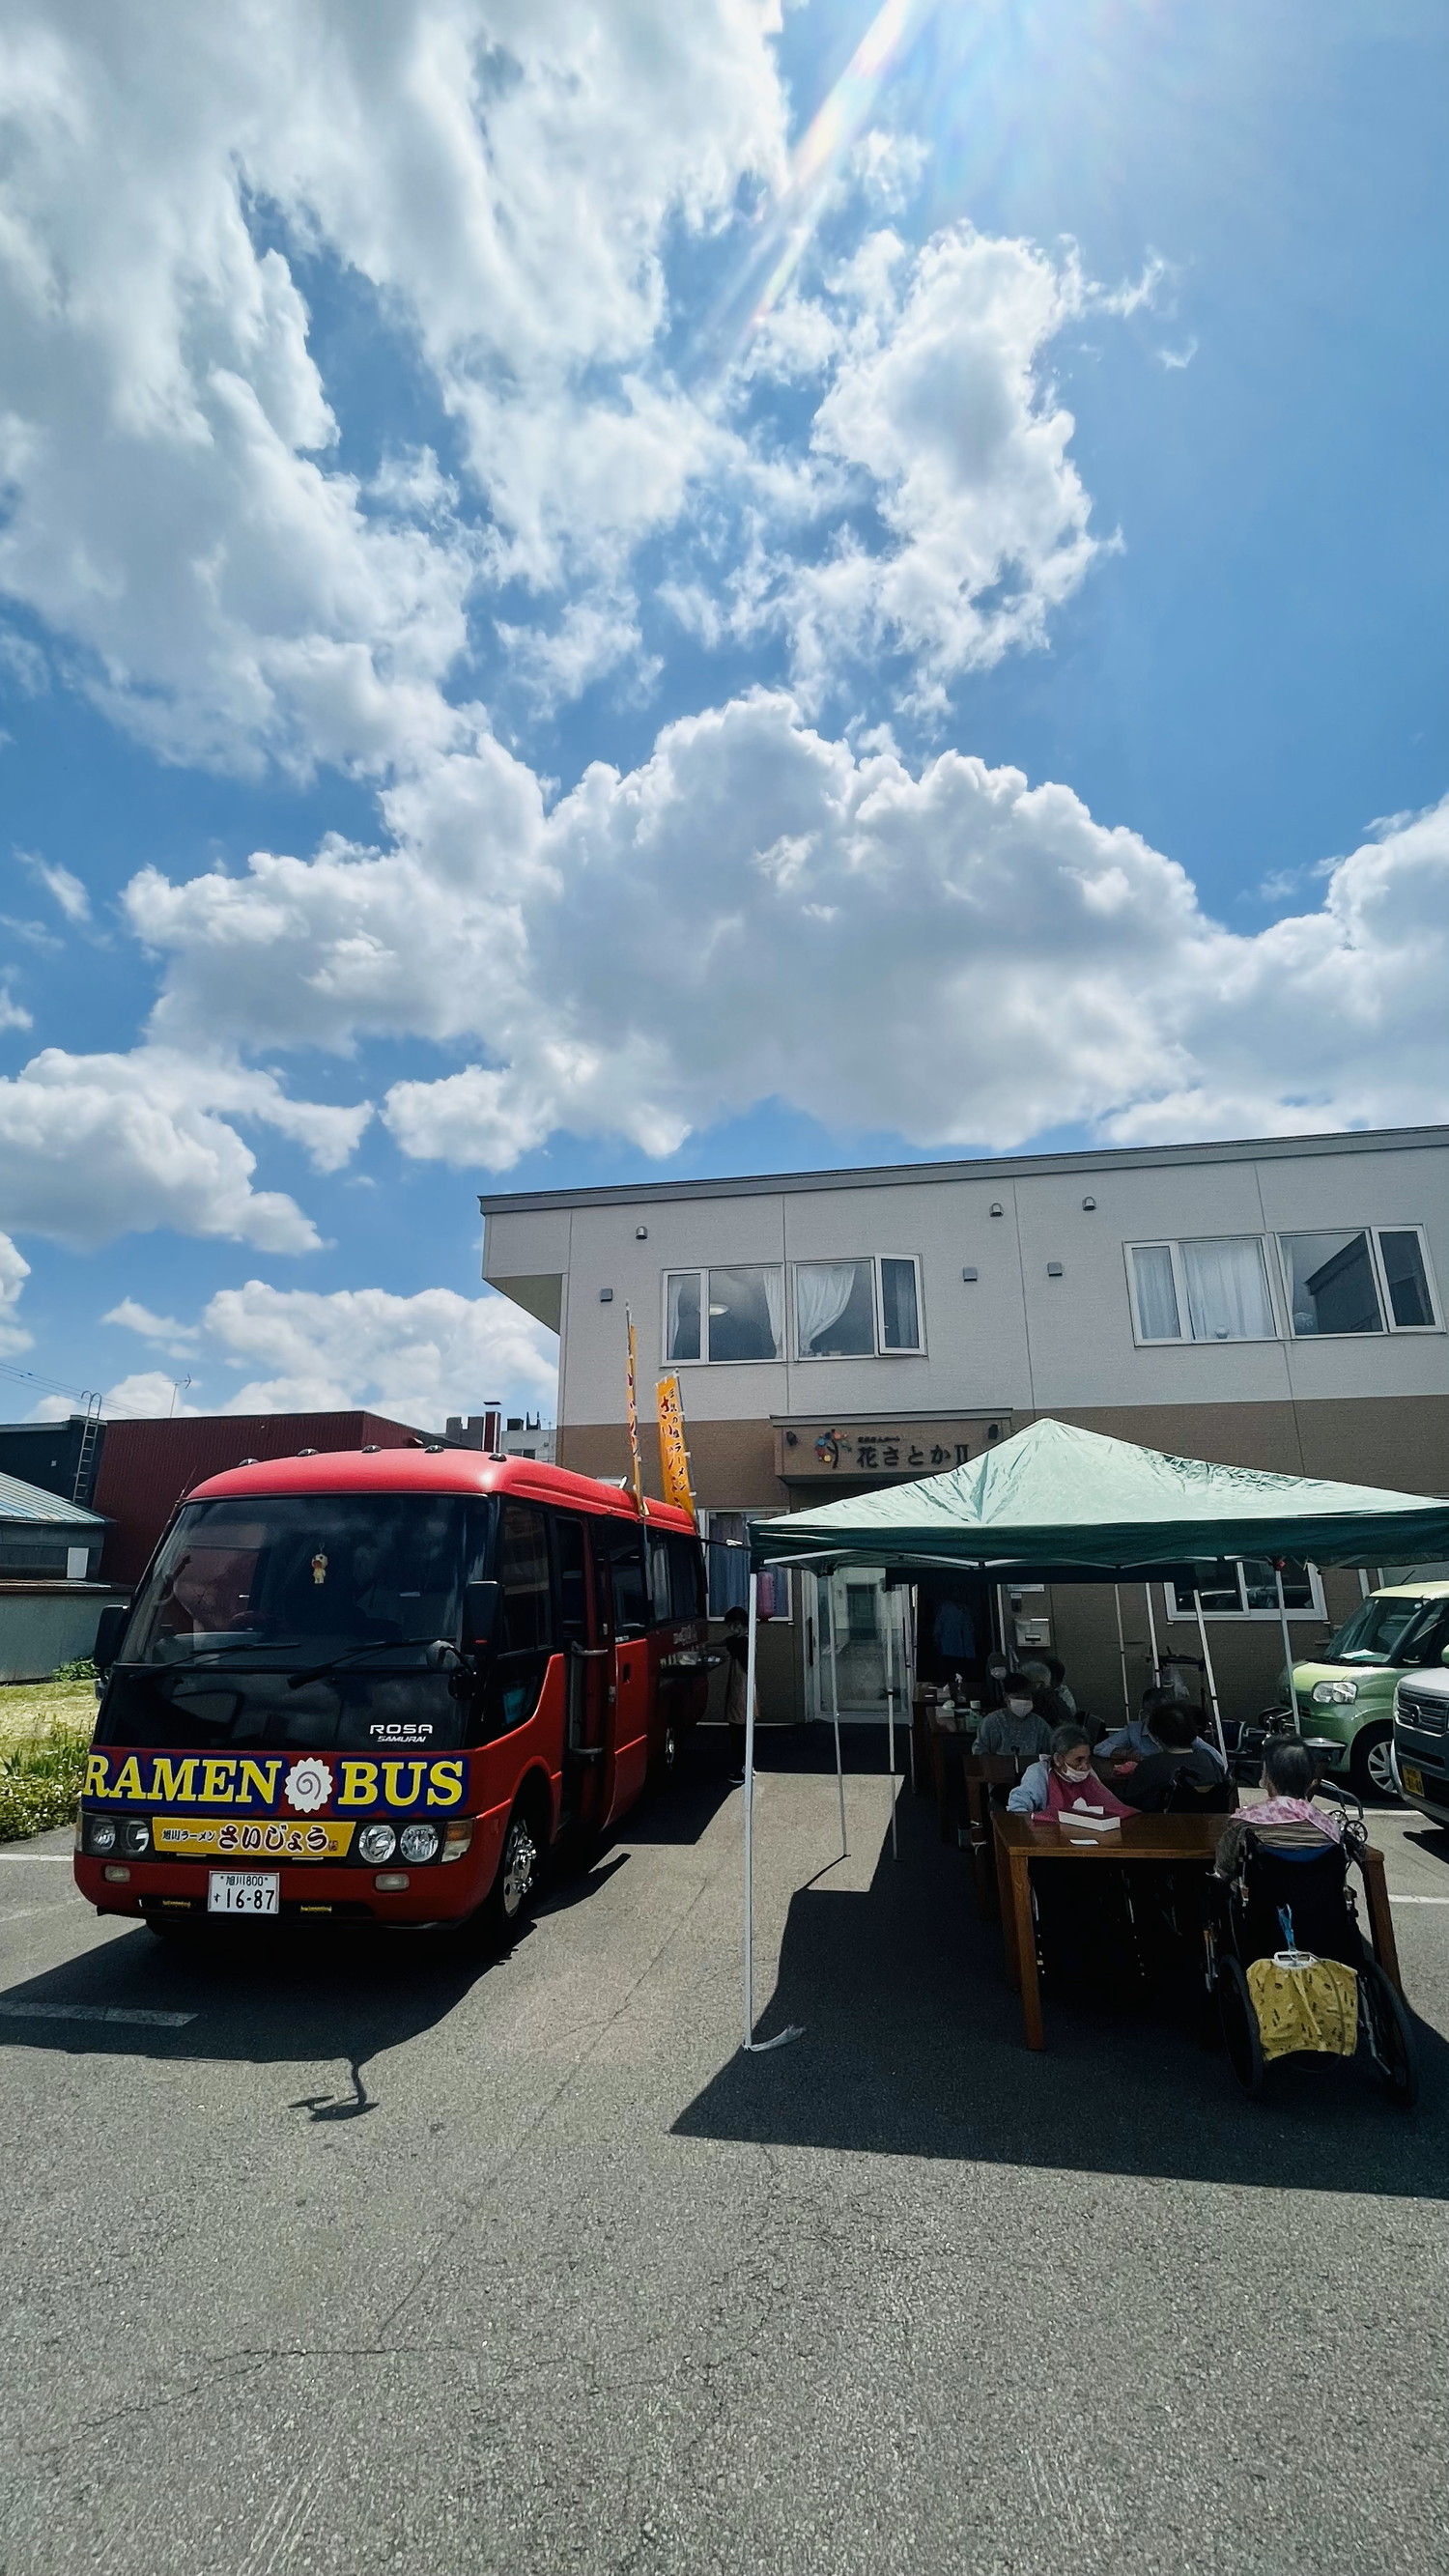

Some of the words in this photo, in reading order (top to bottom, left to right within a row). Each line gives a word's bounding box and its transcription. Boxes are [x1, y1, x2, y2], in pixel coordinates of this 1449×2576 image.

[369, 1724, 434, 1735] ROSA
[82, 1755, 282, 1803] RAMEN
[337, 1760, 464, 1805] BUS
[162, 1828, 216, 1841] 旭川ラーメン
[218, 1825, 327, 1852] さいじょう
[226, 1888, 274, 1910] 16-87
